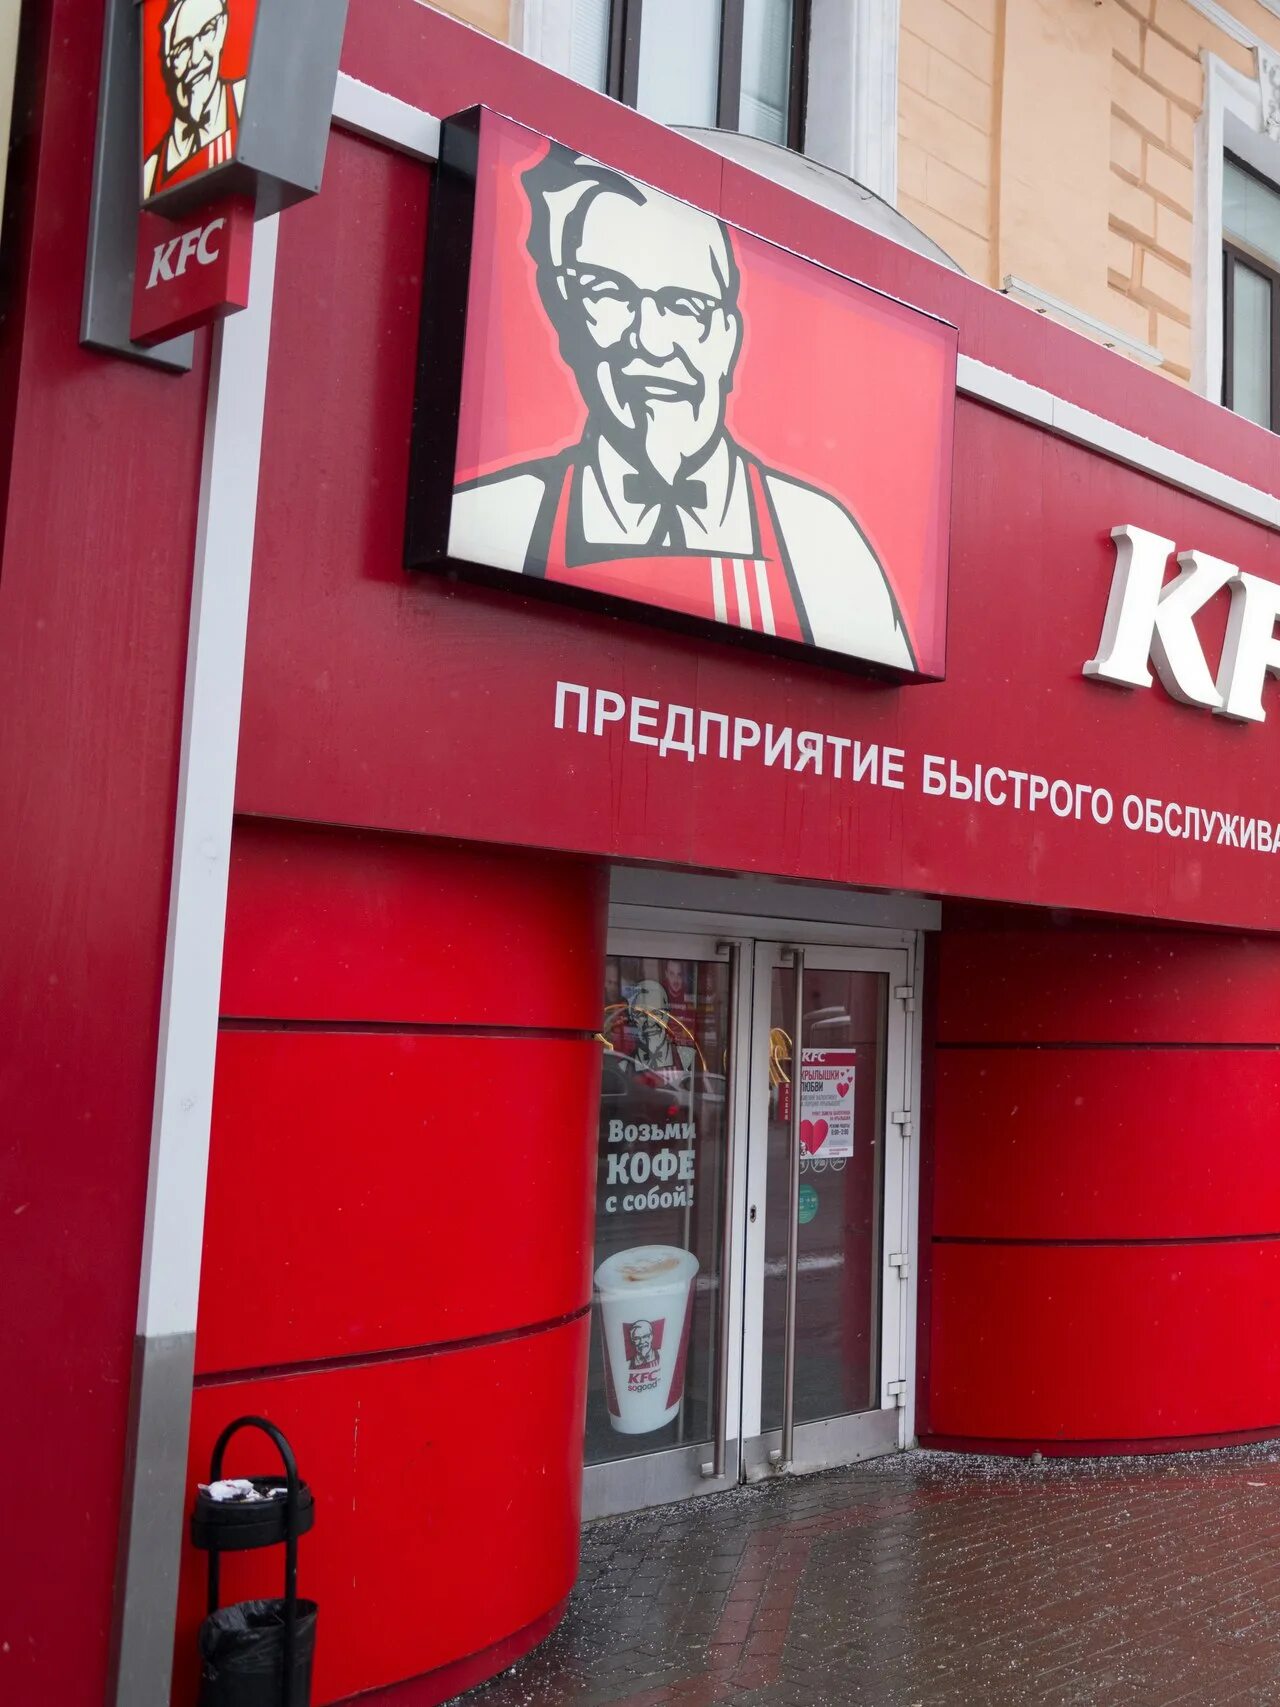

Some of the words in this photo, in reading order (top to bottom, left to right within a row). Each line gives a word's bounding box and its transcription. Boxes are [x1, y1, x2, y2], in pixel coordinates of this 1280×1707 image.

[145, 217, 225, 290] KFC
[554, 681, 905, 790] ПРЕДПРИЯТИЕ
[922, 754, 1114, 824] БЫСТРОГО
[801, 1052, 827, 1062] KFC
[608, 1119, 697, 1142] Возьми
[606, 1148, 696, 1185] КОФЕ
[605, 1195, 618, 1212] с
[622, 1184, 694, 1211] собой!
[628, 1370, 658, 1384] KFC
